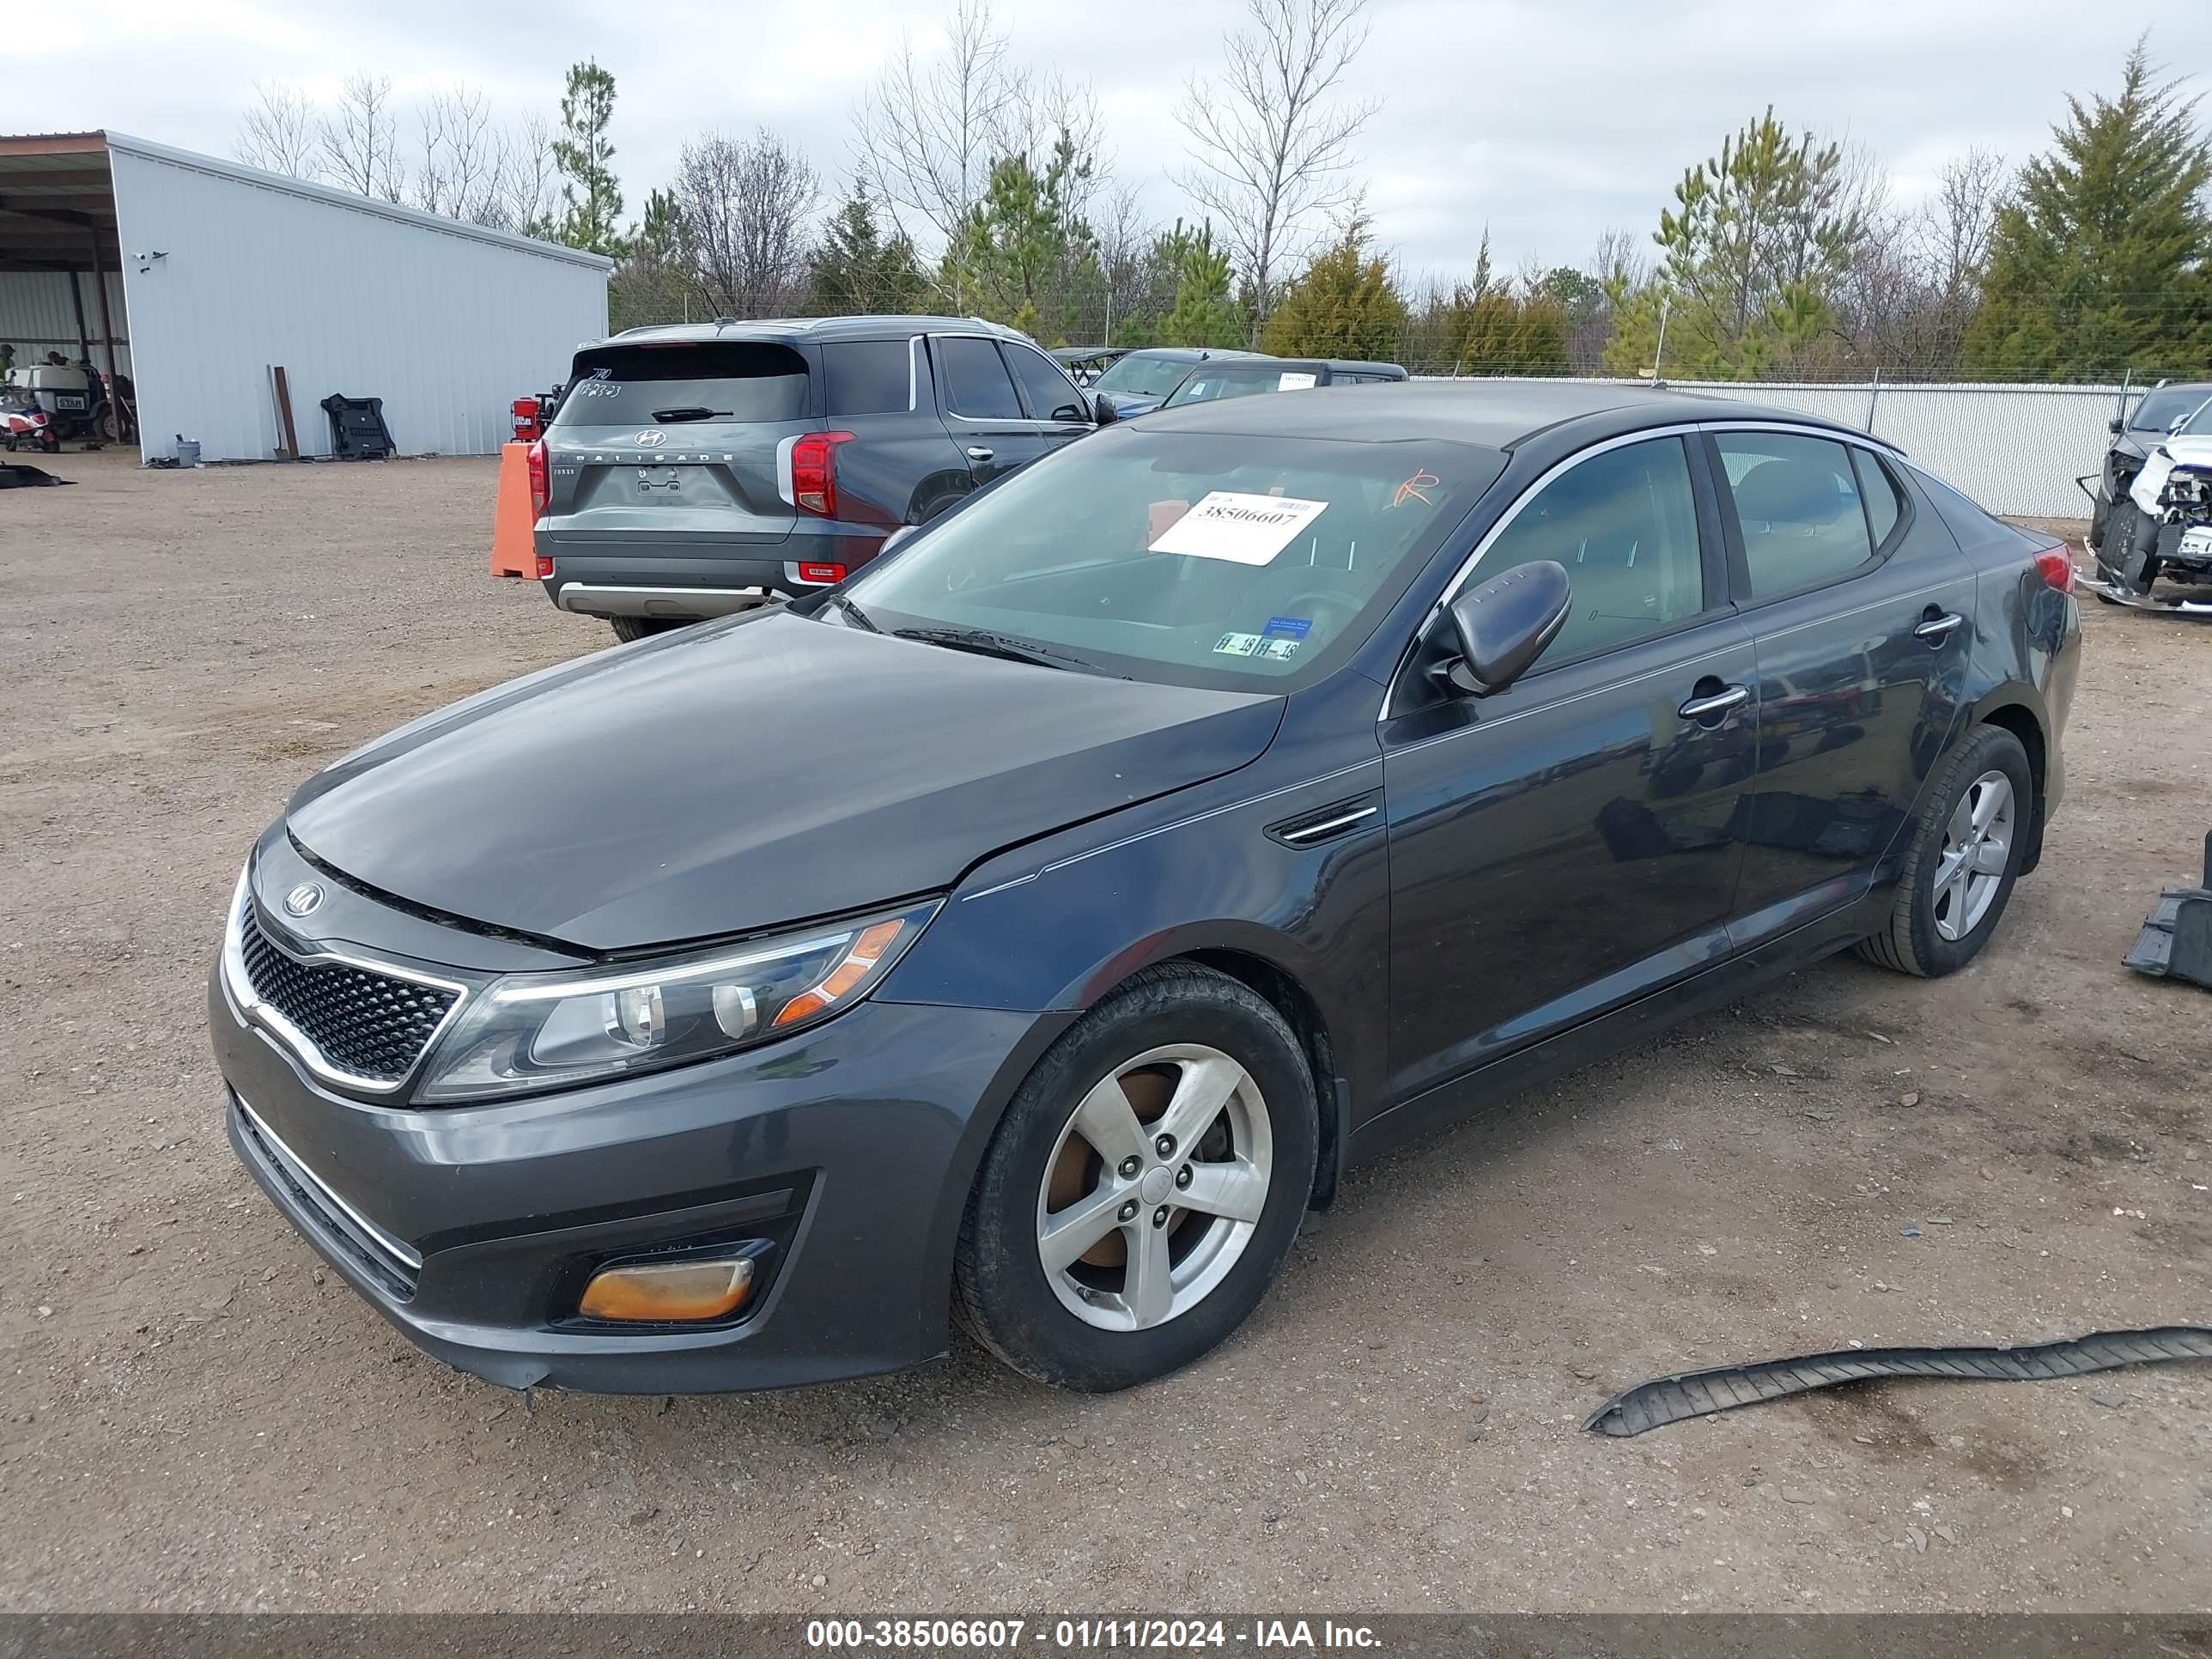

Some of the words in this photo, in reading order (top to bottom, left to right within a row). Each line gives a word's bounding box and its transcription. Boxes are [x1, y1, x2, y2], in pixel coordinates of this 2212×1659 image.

[1199, 506, 1298, 526] 38506607
[1239, 638, 1256, 653] 18
[1280, 642, 1298, 659] 18
